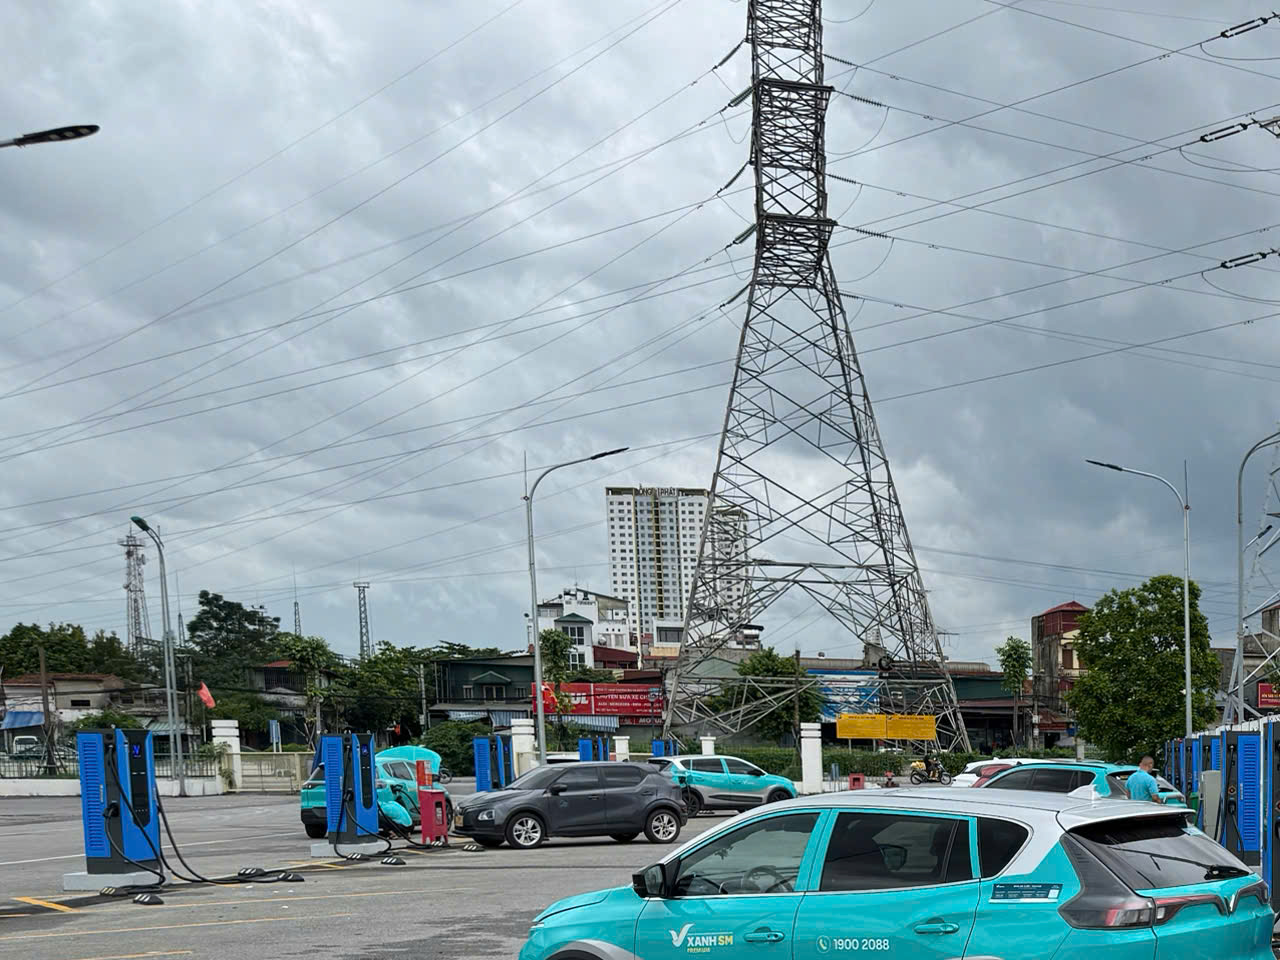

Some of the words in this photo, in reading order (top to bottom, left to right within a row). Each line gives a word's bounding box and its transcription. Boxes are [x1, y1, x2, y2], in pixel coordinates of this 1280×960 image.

[687, 936, 717, 947] XANH
[717, 935, 734, 945] SM
[833, 938, 859, 950] 1900
[861, 938, 890, 950] 2088
